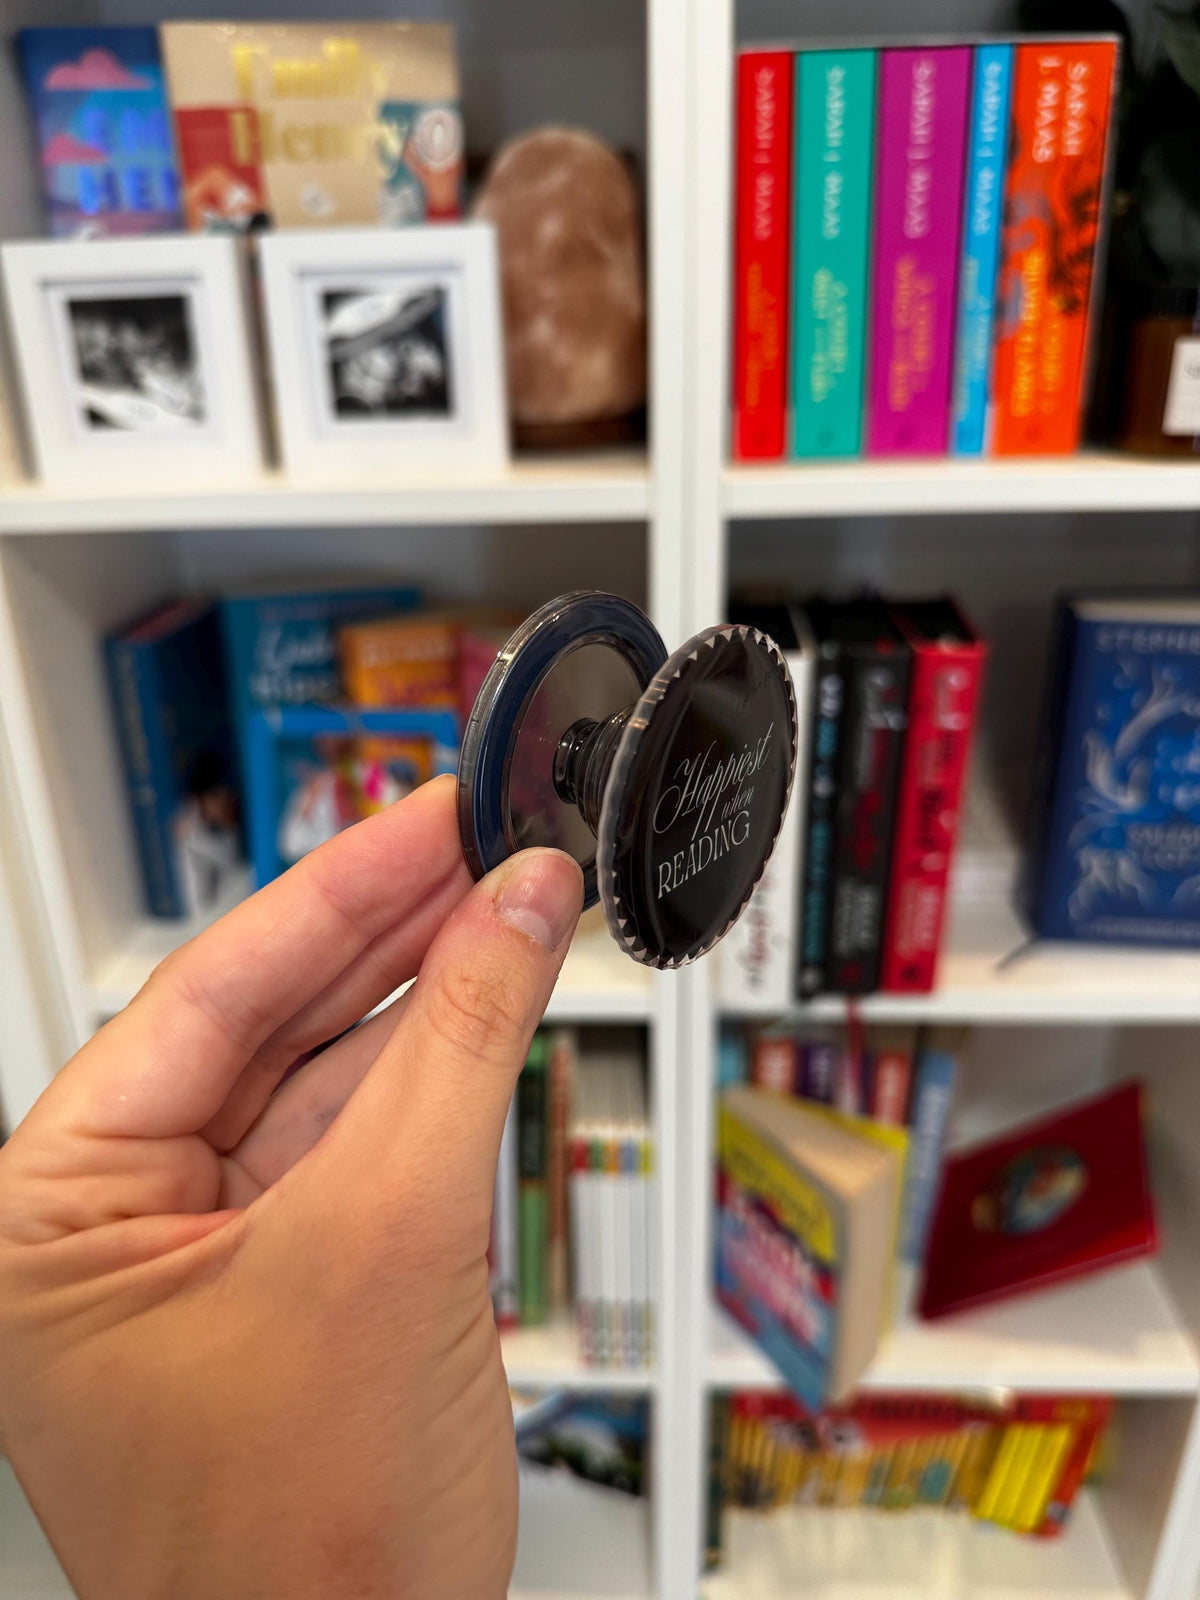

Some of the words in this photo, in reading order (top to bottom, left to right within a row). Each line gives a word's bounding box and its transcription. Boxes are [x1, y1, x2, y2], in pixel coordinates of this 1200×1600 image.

[653, 722, 773, 841] Happiest
[721, 781, 755, 821] when
[658, 810, 750, 899] READING
